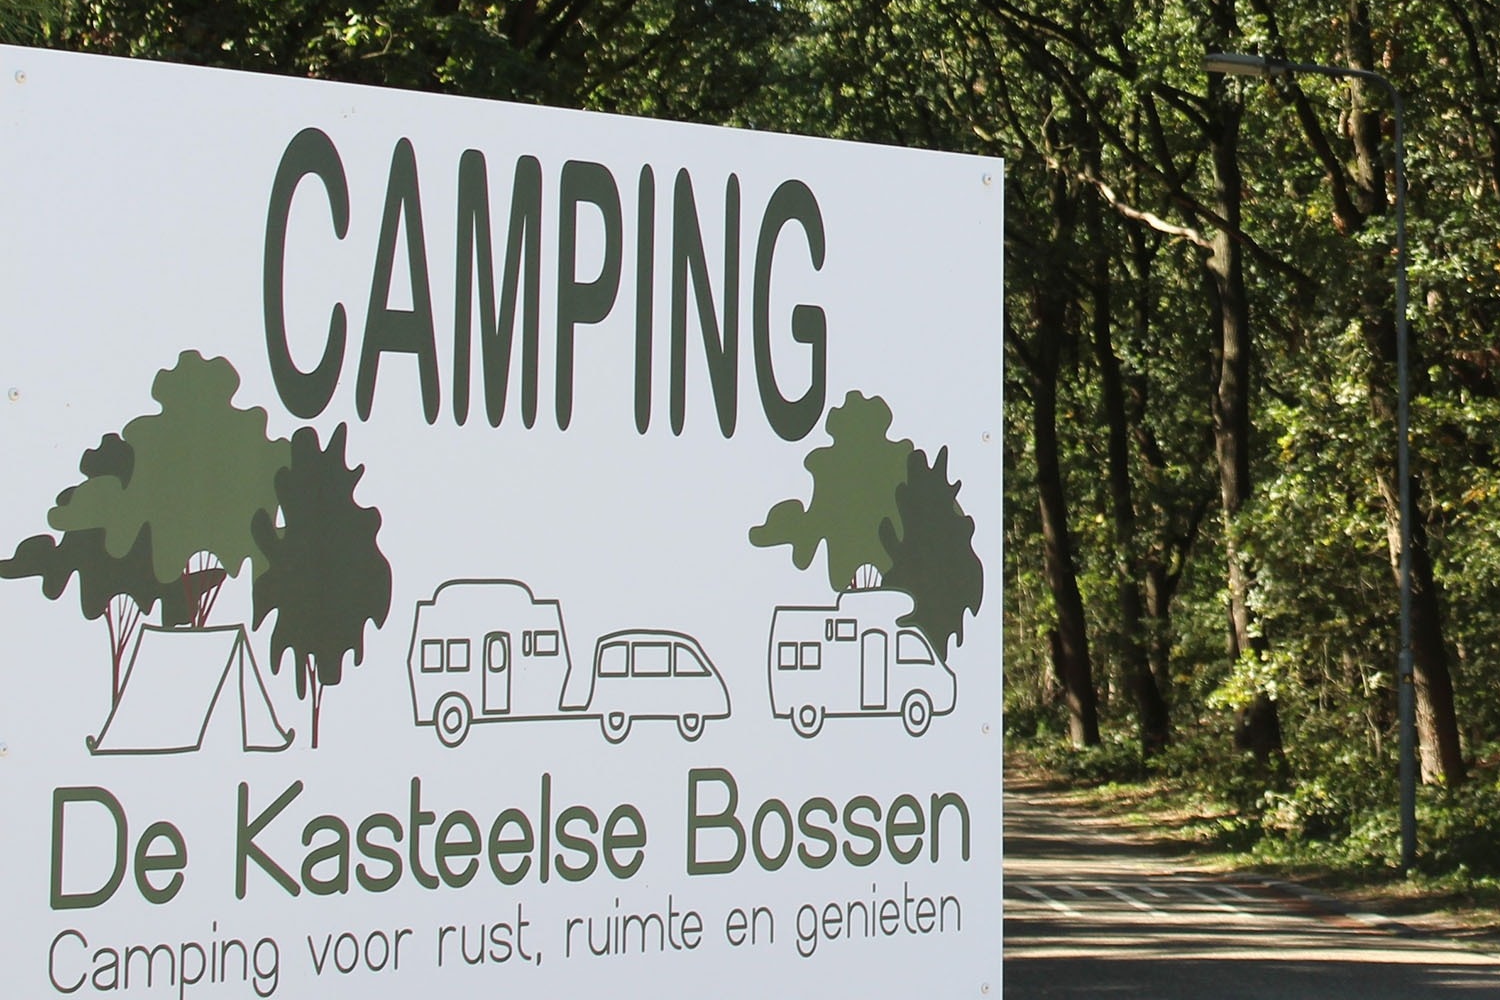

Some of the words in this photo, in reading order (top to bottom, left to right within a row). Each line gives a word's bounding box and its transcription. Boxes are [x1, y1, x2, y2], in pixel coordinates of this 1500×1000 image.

[262, 126, 828, 443] CAMPING
[49, 786, 188, 910] De
[235, 772, 647, 900] Kasteelse
[686, 768, 971, 876] Bossen
[48, 920, 280, 1000] Camping
[307, 928, 414, 976] voor
[438, 903, 544, 968] rust,
[565, 894, 703, 958] ruimte
[725, 903, 774, 947] en
[795, 880, 961, 958] genieten
